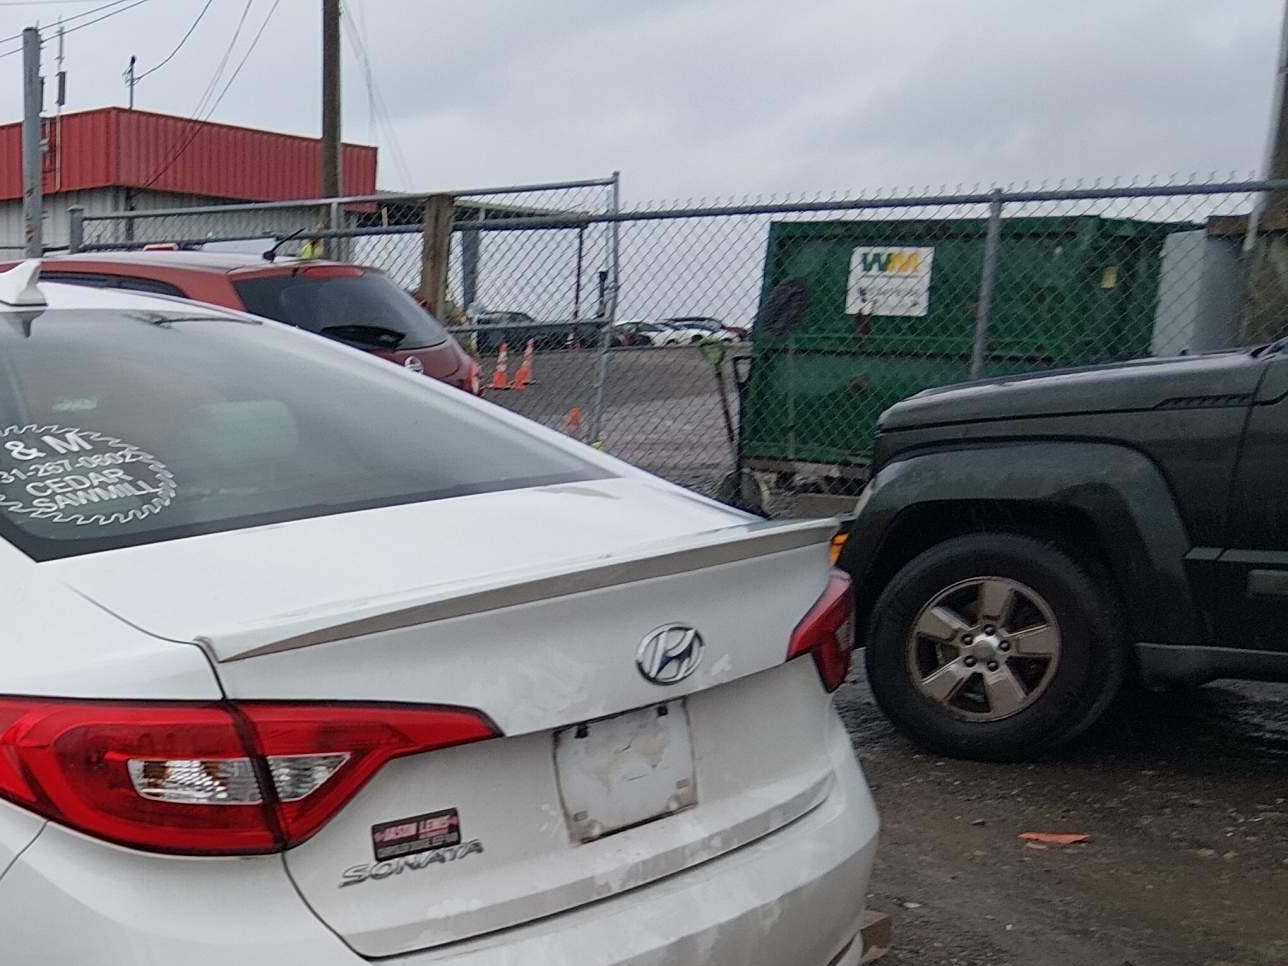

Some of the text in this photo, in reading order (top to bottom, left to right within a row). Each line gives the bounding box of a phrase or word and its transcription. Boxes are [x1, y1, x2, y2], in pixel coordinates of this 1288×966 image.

[861, 251, 921, 273] WM
[4, 440, 47, 461] &
[41, 432, 94, 454] M
[25, 468, 133, 497] CEDAR
[32, 480, 162, 513] SAWMILL
[338, 838, 484, 889] SONATA
